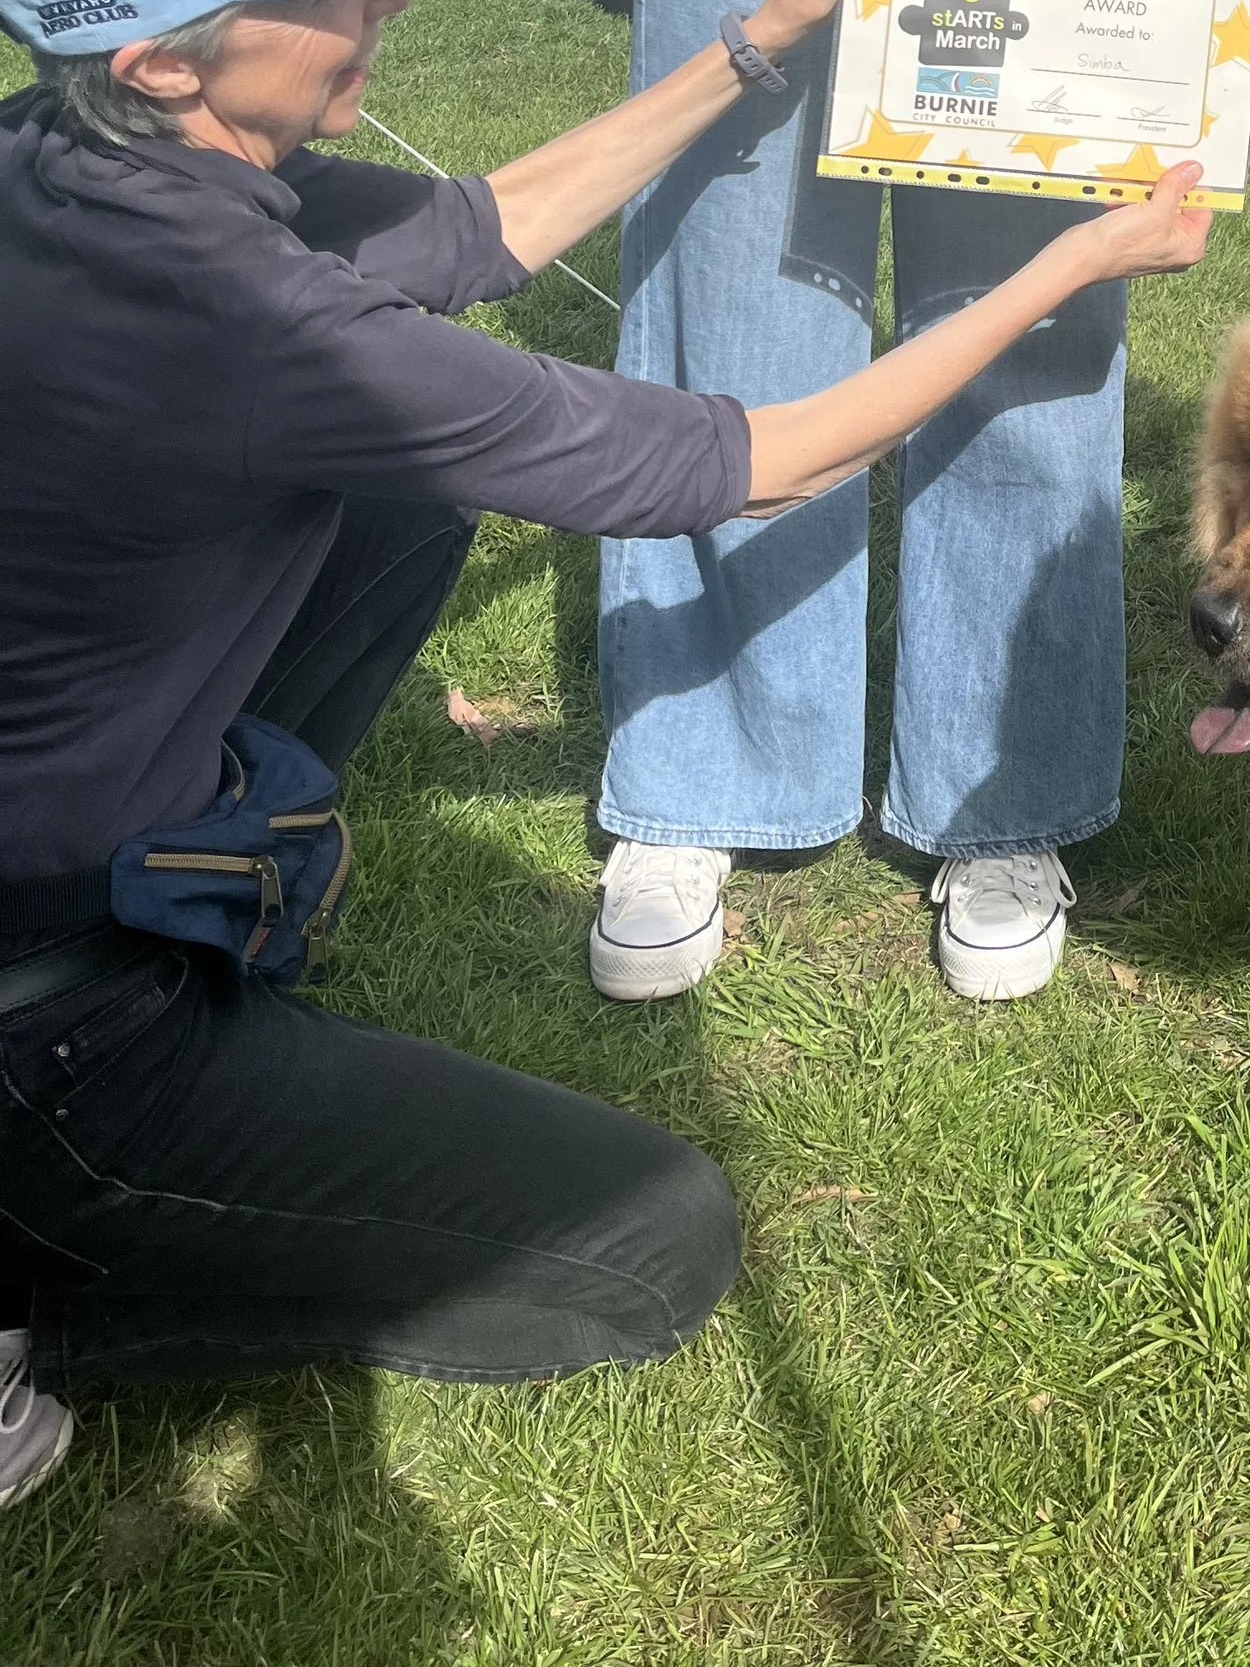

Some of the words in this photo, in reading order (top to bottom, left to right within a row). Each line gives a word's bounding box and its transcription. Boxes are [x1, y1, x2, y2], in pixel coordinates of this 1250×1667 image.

[83, 3, 139, 25] CLUB
[932, 9, 1005, 31] stARTs
[1012, 20, 1022, 31] in
[935, 30, 1000, 50] March
[1075, 22, 1134, 39] Awarded
[1078, 53, 1131, 72] Simba
[914, 94, 998, 116] BURNIE
[912, 113, 937, 122] CITY
[945, 115, 996, 127] COUNCIL
